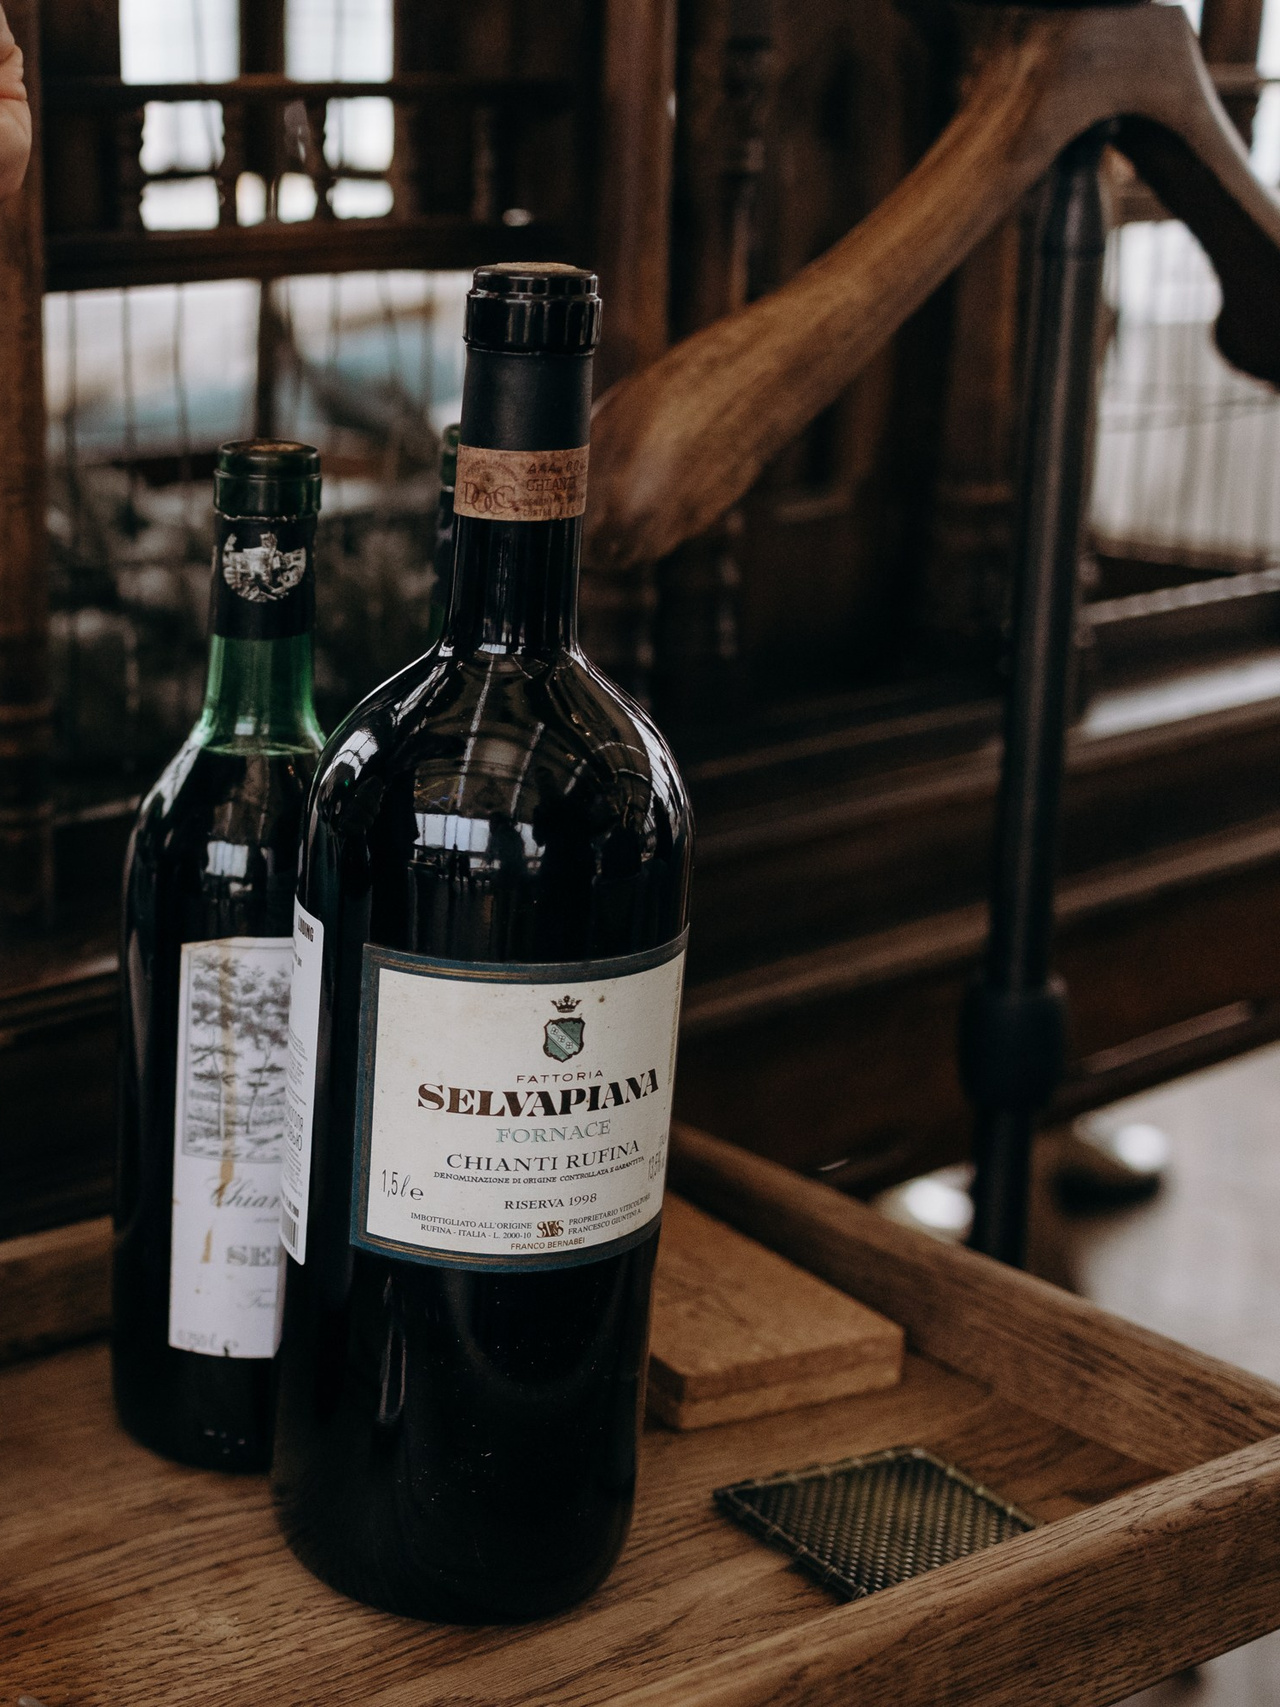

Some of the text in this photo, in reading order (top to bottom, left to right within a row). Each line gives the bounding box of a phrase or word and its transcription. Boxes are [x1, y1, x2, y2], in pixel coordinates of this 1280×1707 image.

[516, 1069, 604, 1084] FATTORIA
[417, 1068, 659, 1117] SELVAPIANA
[496, 1119, 612, 1144] FORNACE
[446, 1153, 558, 1172] CHIANTI
[566, 1140, 640, 1169] RUFINA
[433, 1171, 510, 1184] DENOMINAZIONE
[523, 1176, 557, 1184] ORIGINE
[560, 1169, 609, 1182] CONTROLLATA
[615, 1156, 645, 1172] GARANTITA
[381, 1169, 398, 1198] 1,5
[504, 1193, 598, 1210] RISERVA 1998
[411, 1212, 532, 1230] IMBOTTIGLIATO ALL'ORIGINE
[568, 1208, 618, 1226] PROPRIETARIO
[421, 1224, 452, 1235] RUFINA
[458, 1229, 487, 1239] ITALIA
[503, 1231, 532, 1240] 2000-10
[568, 1221, 610, 1235] FRANCESCO
[510, 1237, 586, 1250] FRANCO BERNABEI
